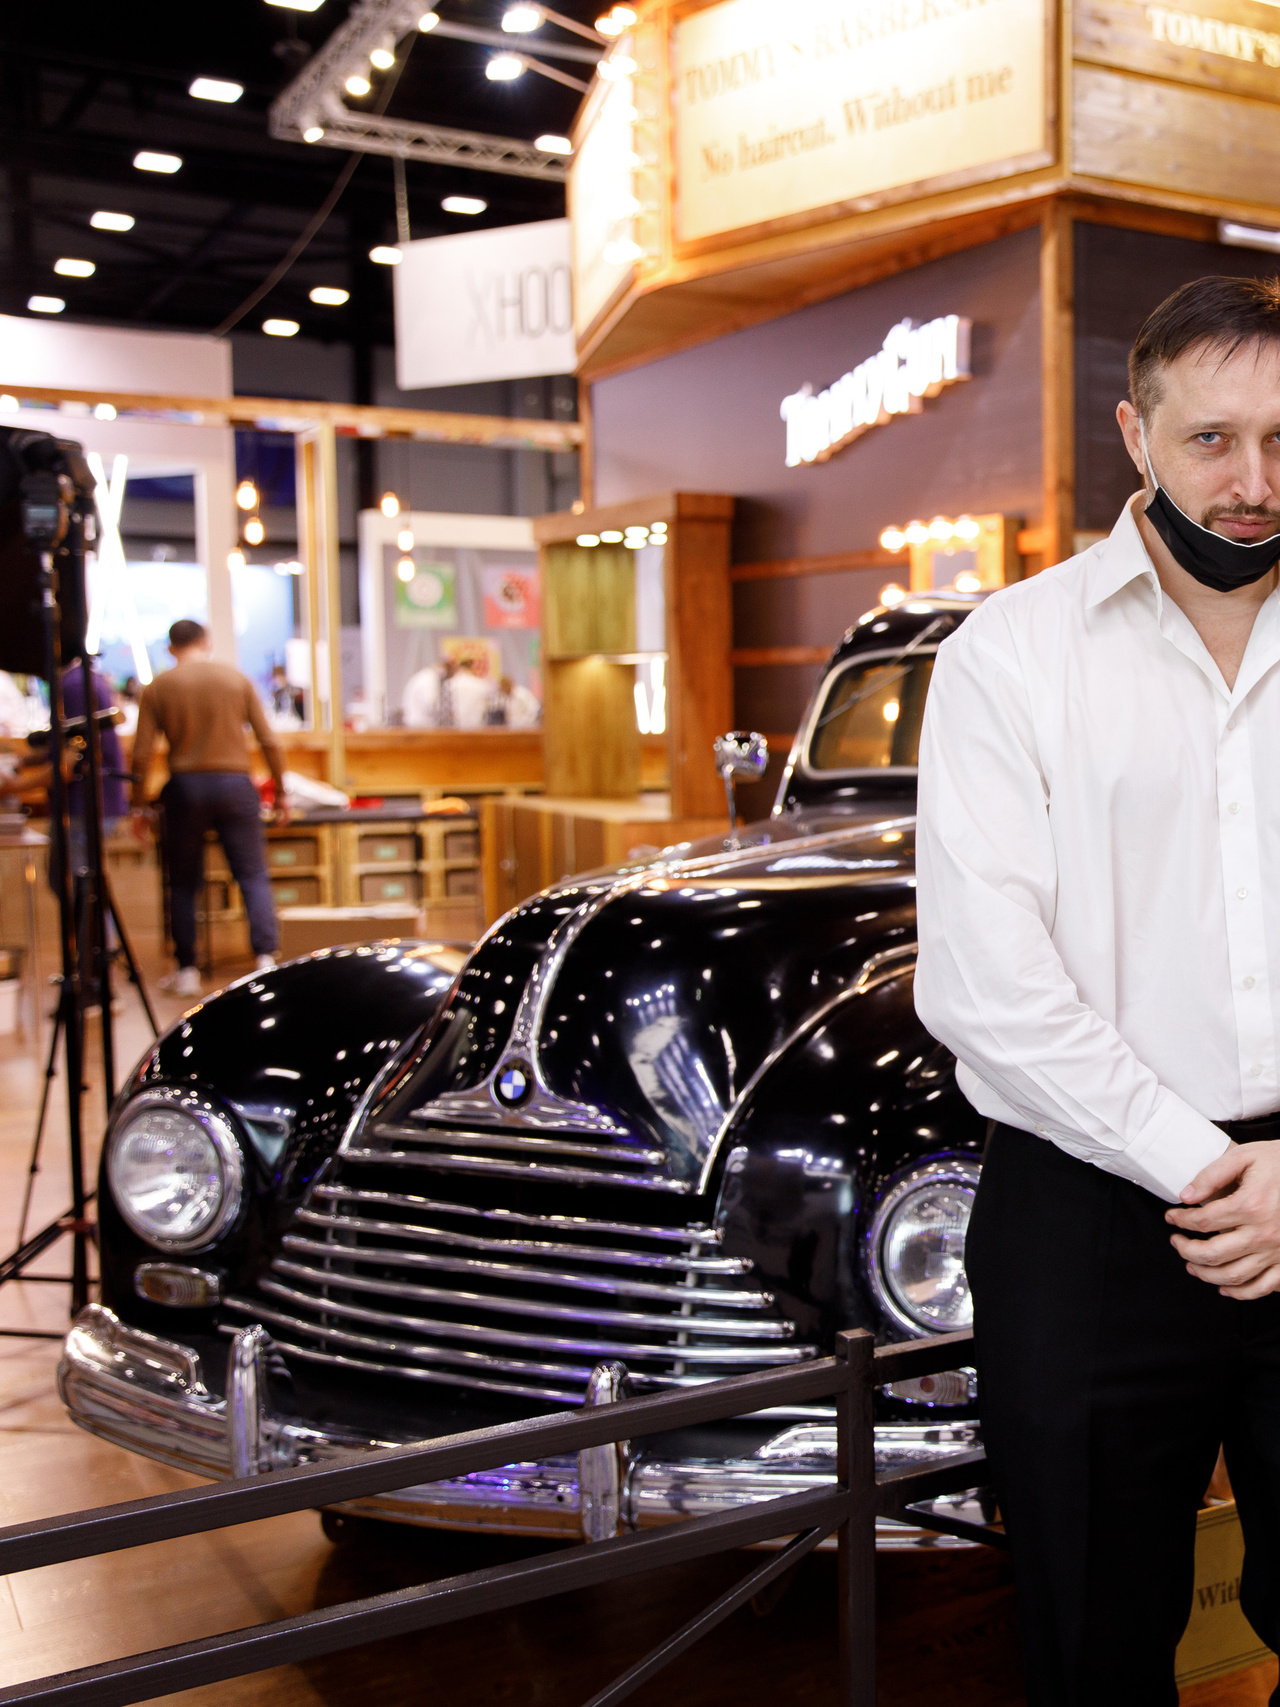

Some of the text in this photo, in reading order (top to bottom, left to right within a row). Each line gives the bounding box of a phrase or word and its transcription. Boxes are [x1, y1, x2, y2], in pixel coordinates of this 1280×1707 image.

[700, 139, 736, 183] No
[841, 82, 957, 138] Without
[965, 64, 1015, 105] me
